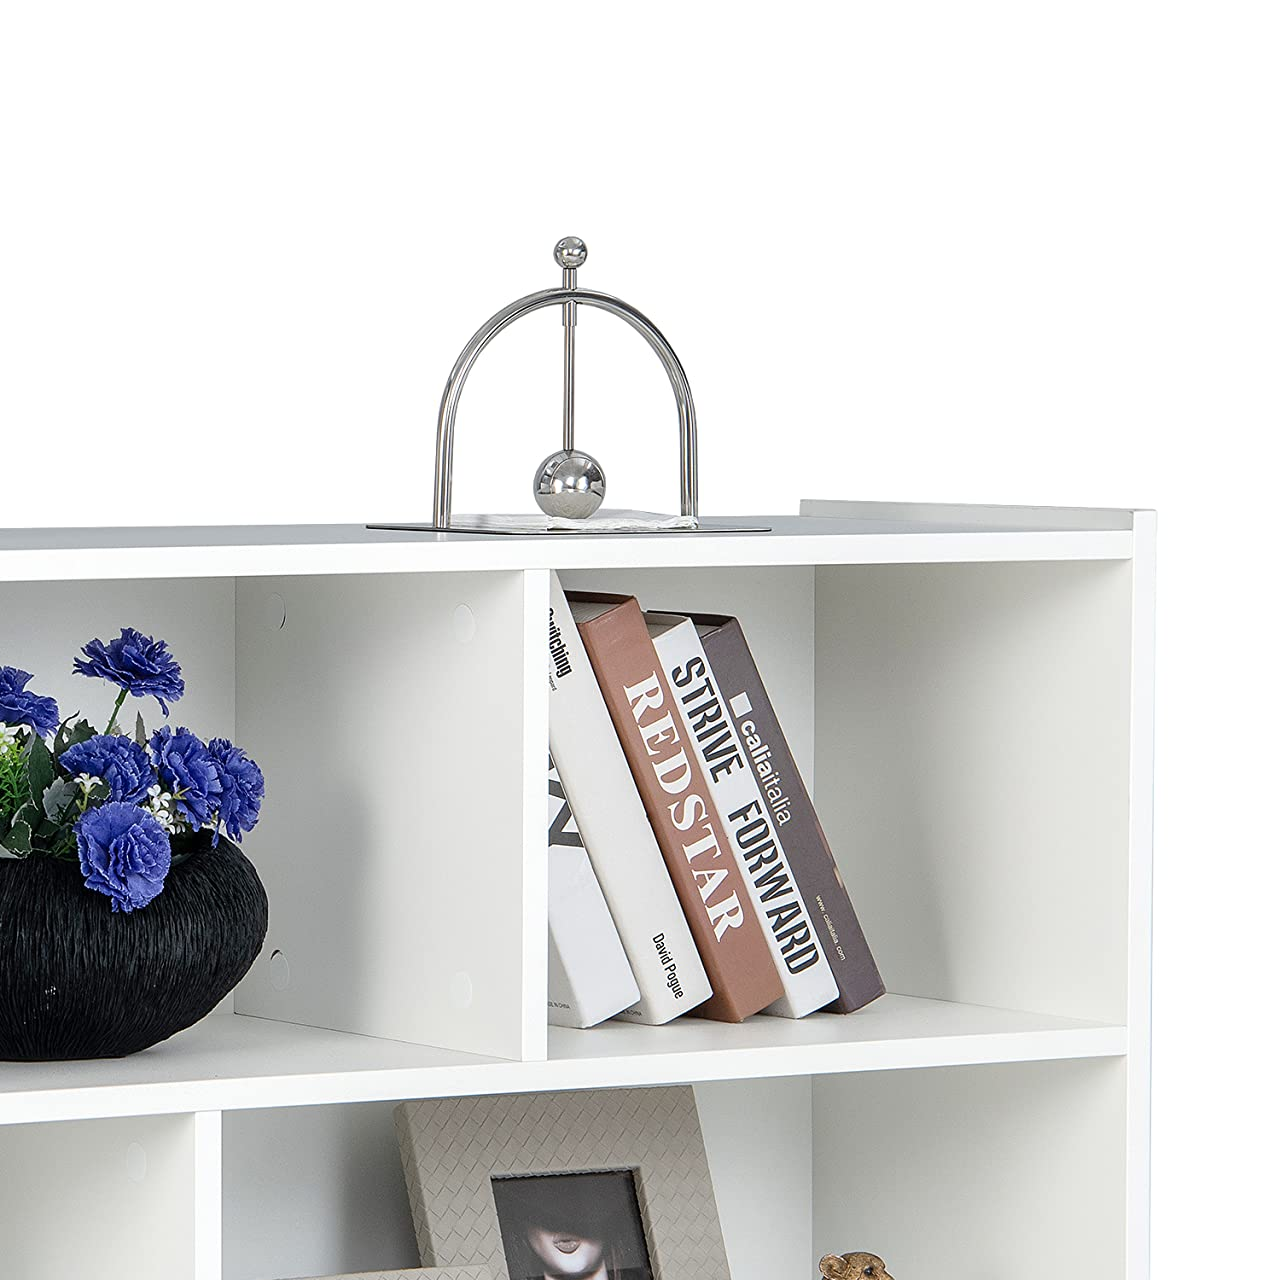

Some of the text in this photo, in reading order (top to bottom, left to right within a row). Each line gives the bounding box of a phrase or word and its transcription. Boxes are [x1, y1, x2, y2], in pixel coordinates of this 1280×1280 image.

[623, 670, 745, 943] REDSTAR
[672, 656, 821, 975] STRIVE FORWARD
[740, 720, 791, 827] caliaitalia
[652, 932, 684, 1000] David Pogue
